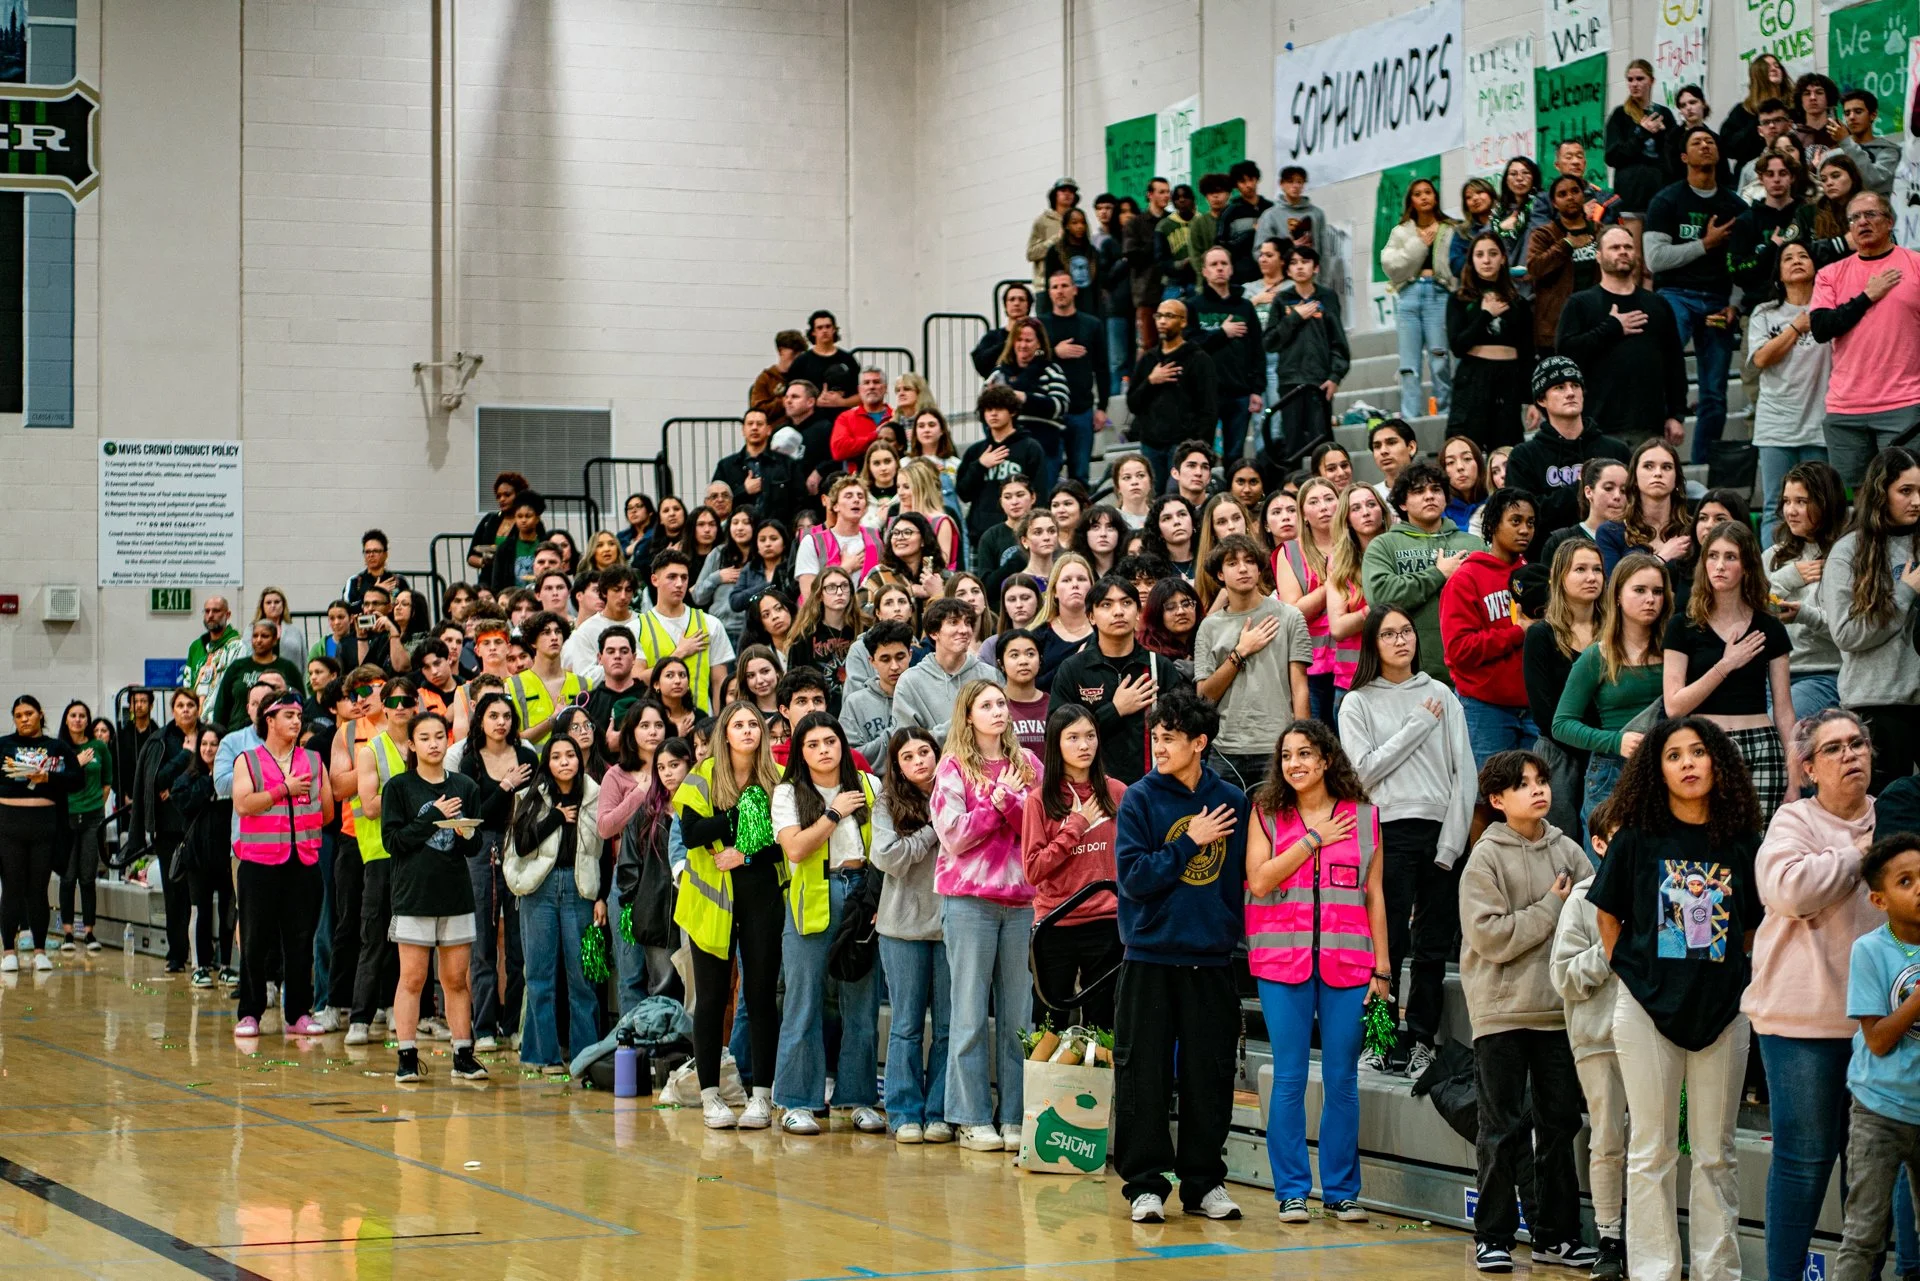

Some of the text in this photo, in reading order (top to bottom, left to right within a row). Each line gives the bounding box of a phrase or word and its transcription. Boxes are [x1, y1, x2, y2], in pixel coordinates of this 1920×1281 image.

[1836, 24, 1871, 58] We
[1290, 33, 1452, 160] SOPHOMORES
[118, 445, 239, 456] MVHS CROWD CONDUCT POLICY
[158, 589, 187, 609] EXIT
[1012, 719, 1046, 734] ARVA
[1087, 842, 1100, 852] DO
[1100, 841, 1107, 850] IT
[1184, 869, 1209, 879] NAVY
